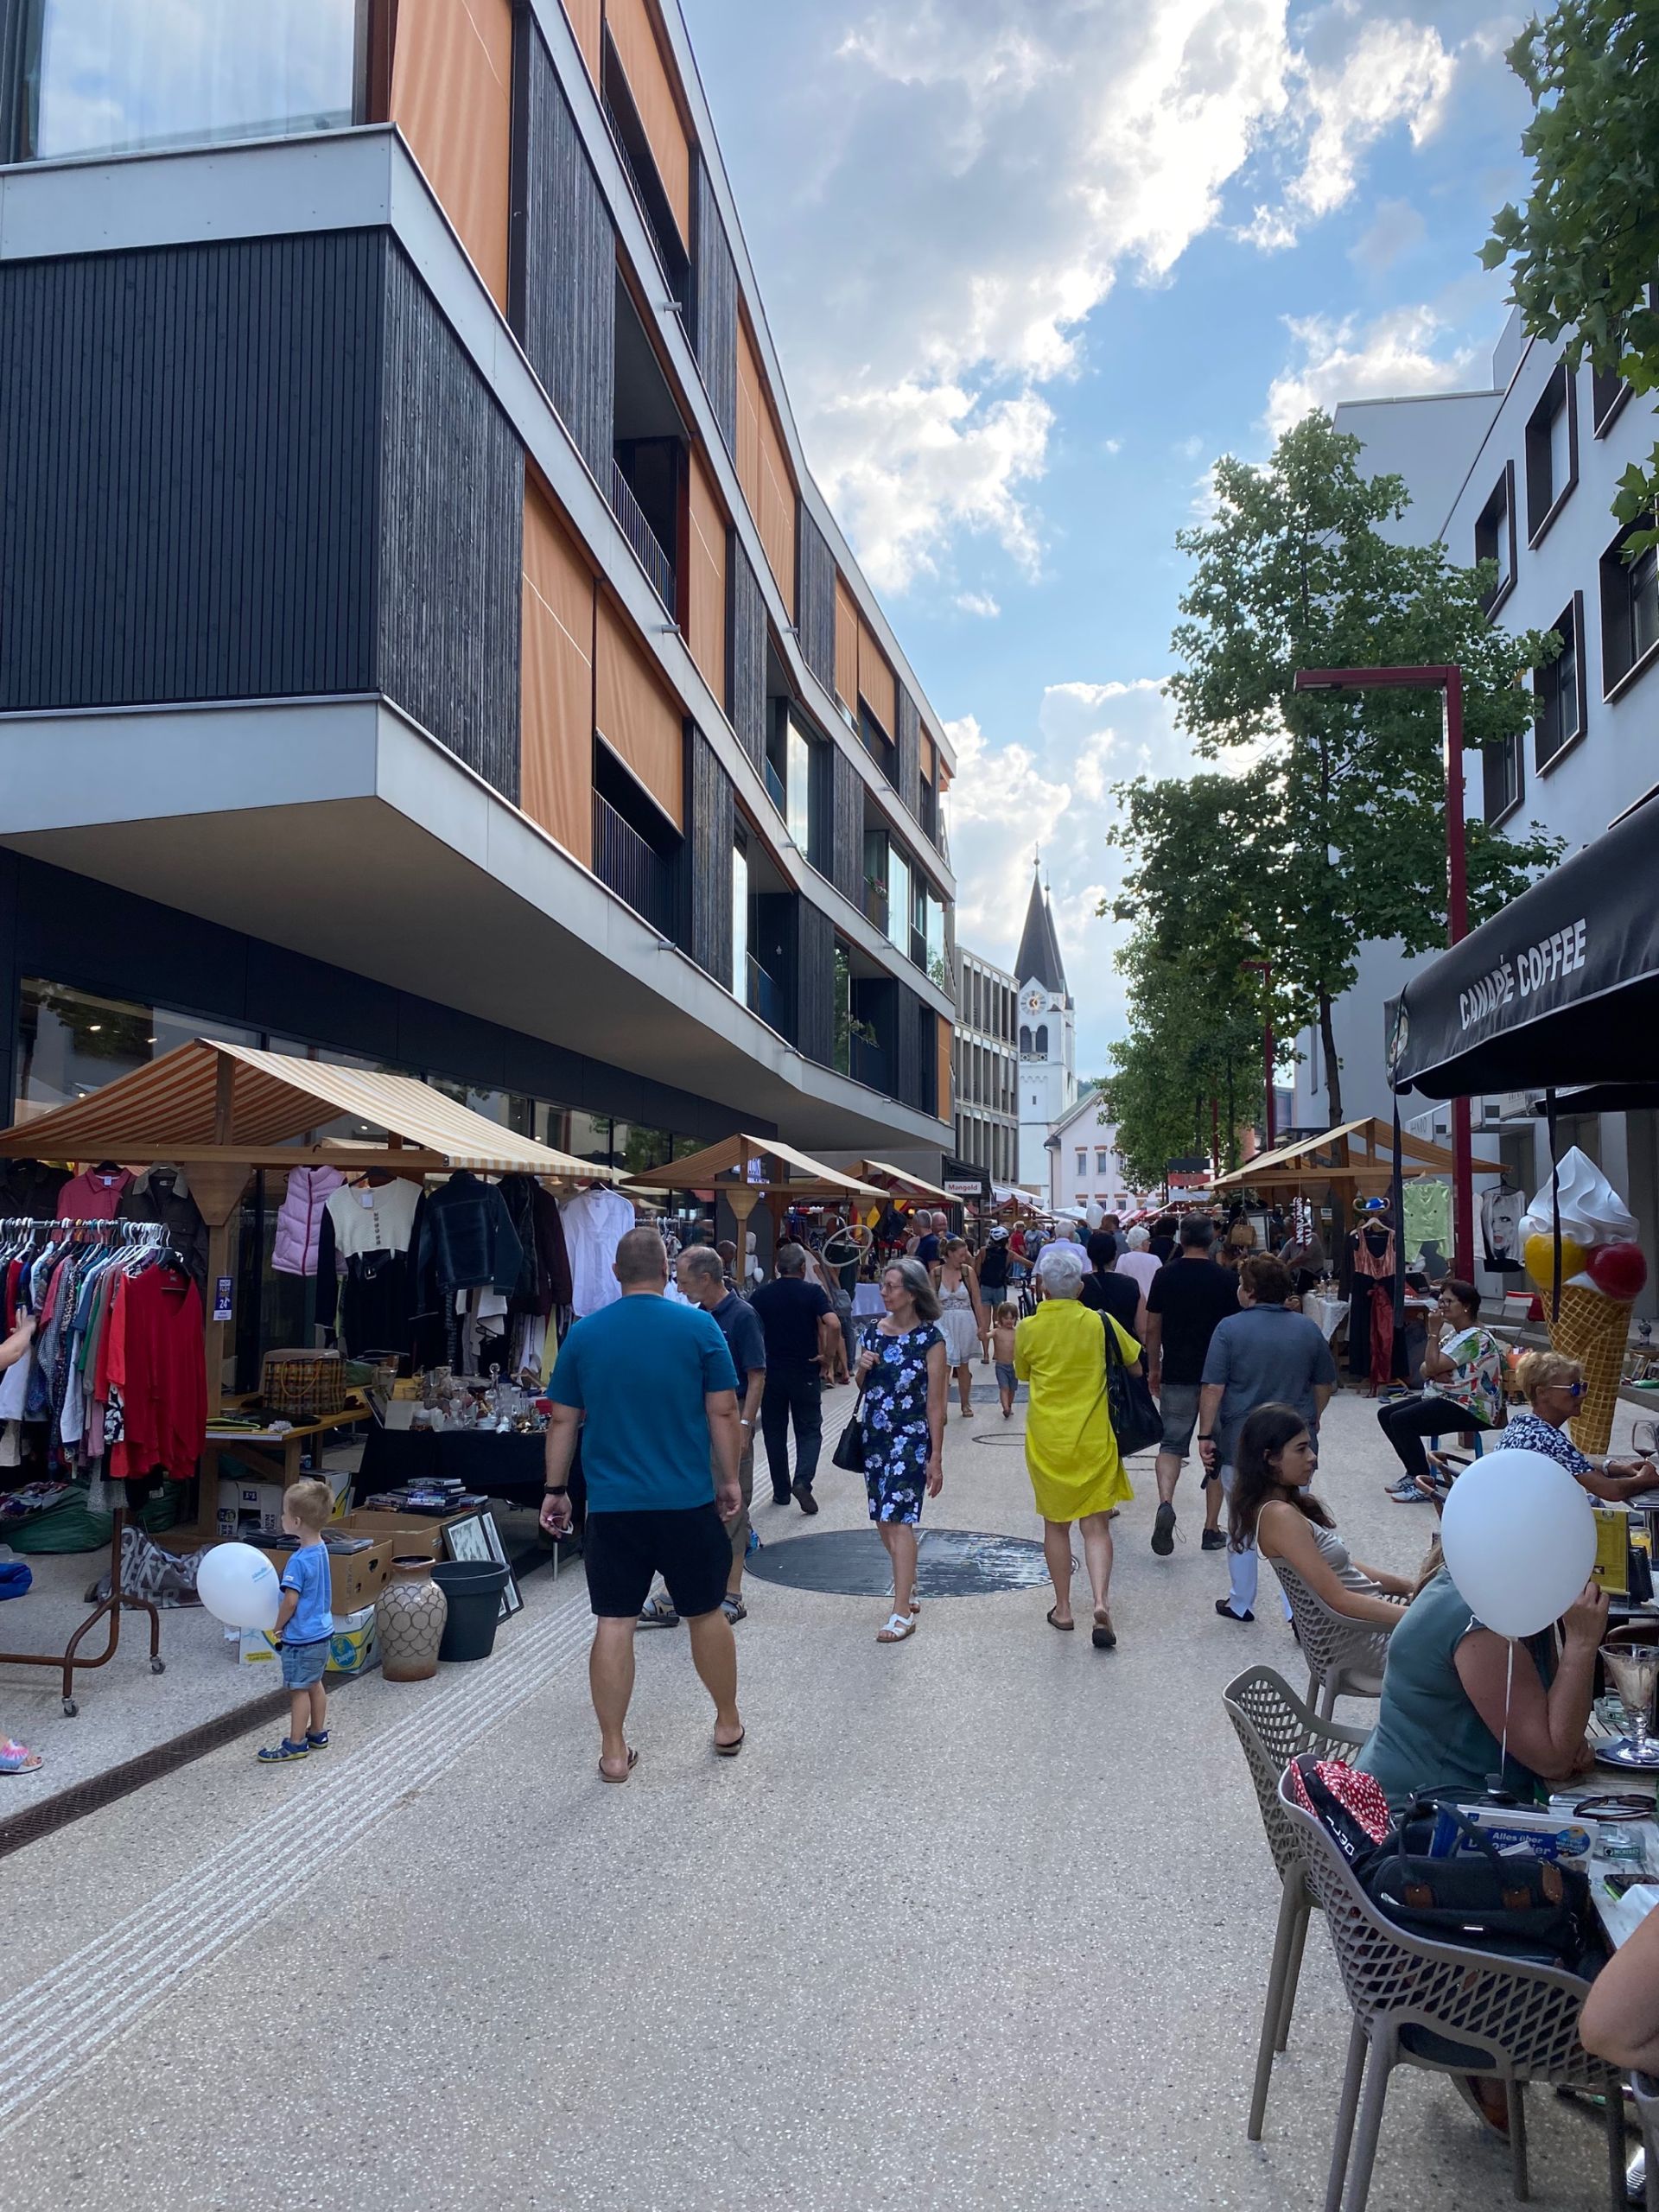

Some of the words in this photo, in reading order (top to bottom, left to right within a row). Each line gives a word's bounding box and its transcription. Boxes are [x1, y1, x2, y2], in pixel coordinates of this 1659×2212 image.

[1459, 954, 1515, 1030] CANAPÉ
[1517, 918, 1586, 997] COFFEE
[1492, 1832, 1517, 1842] Alles
[1519, 1833, 1543, 1843] über
